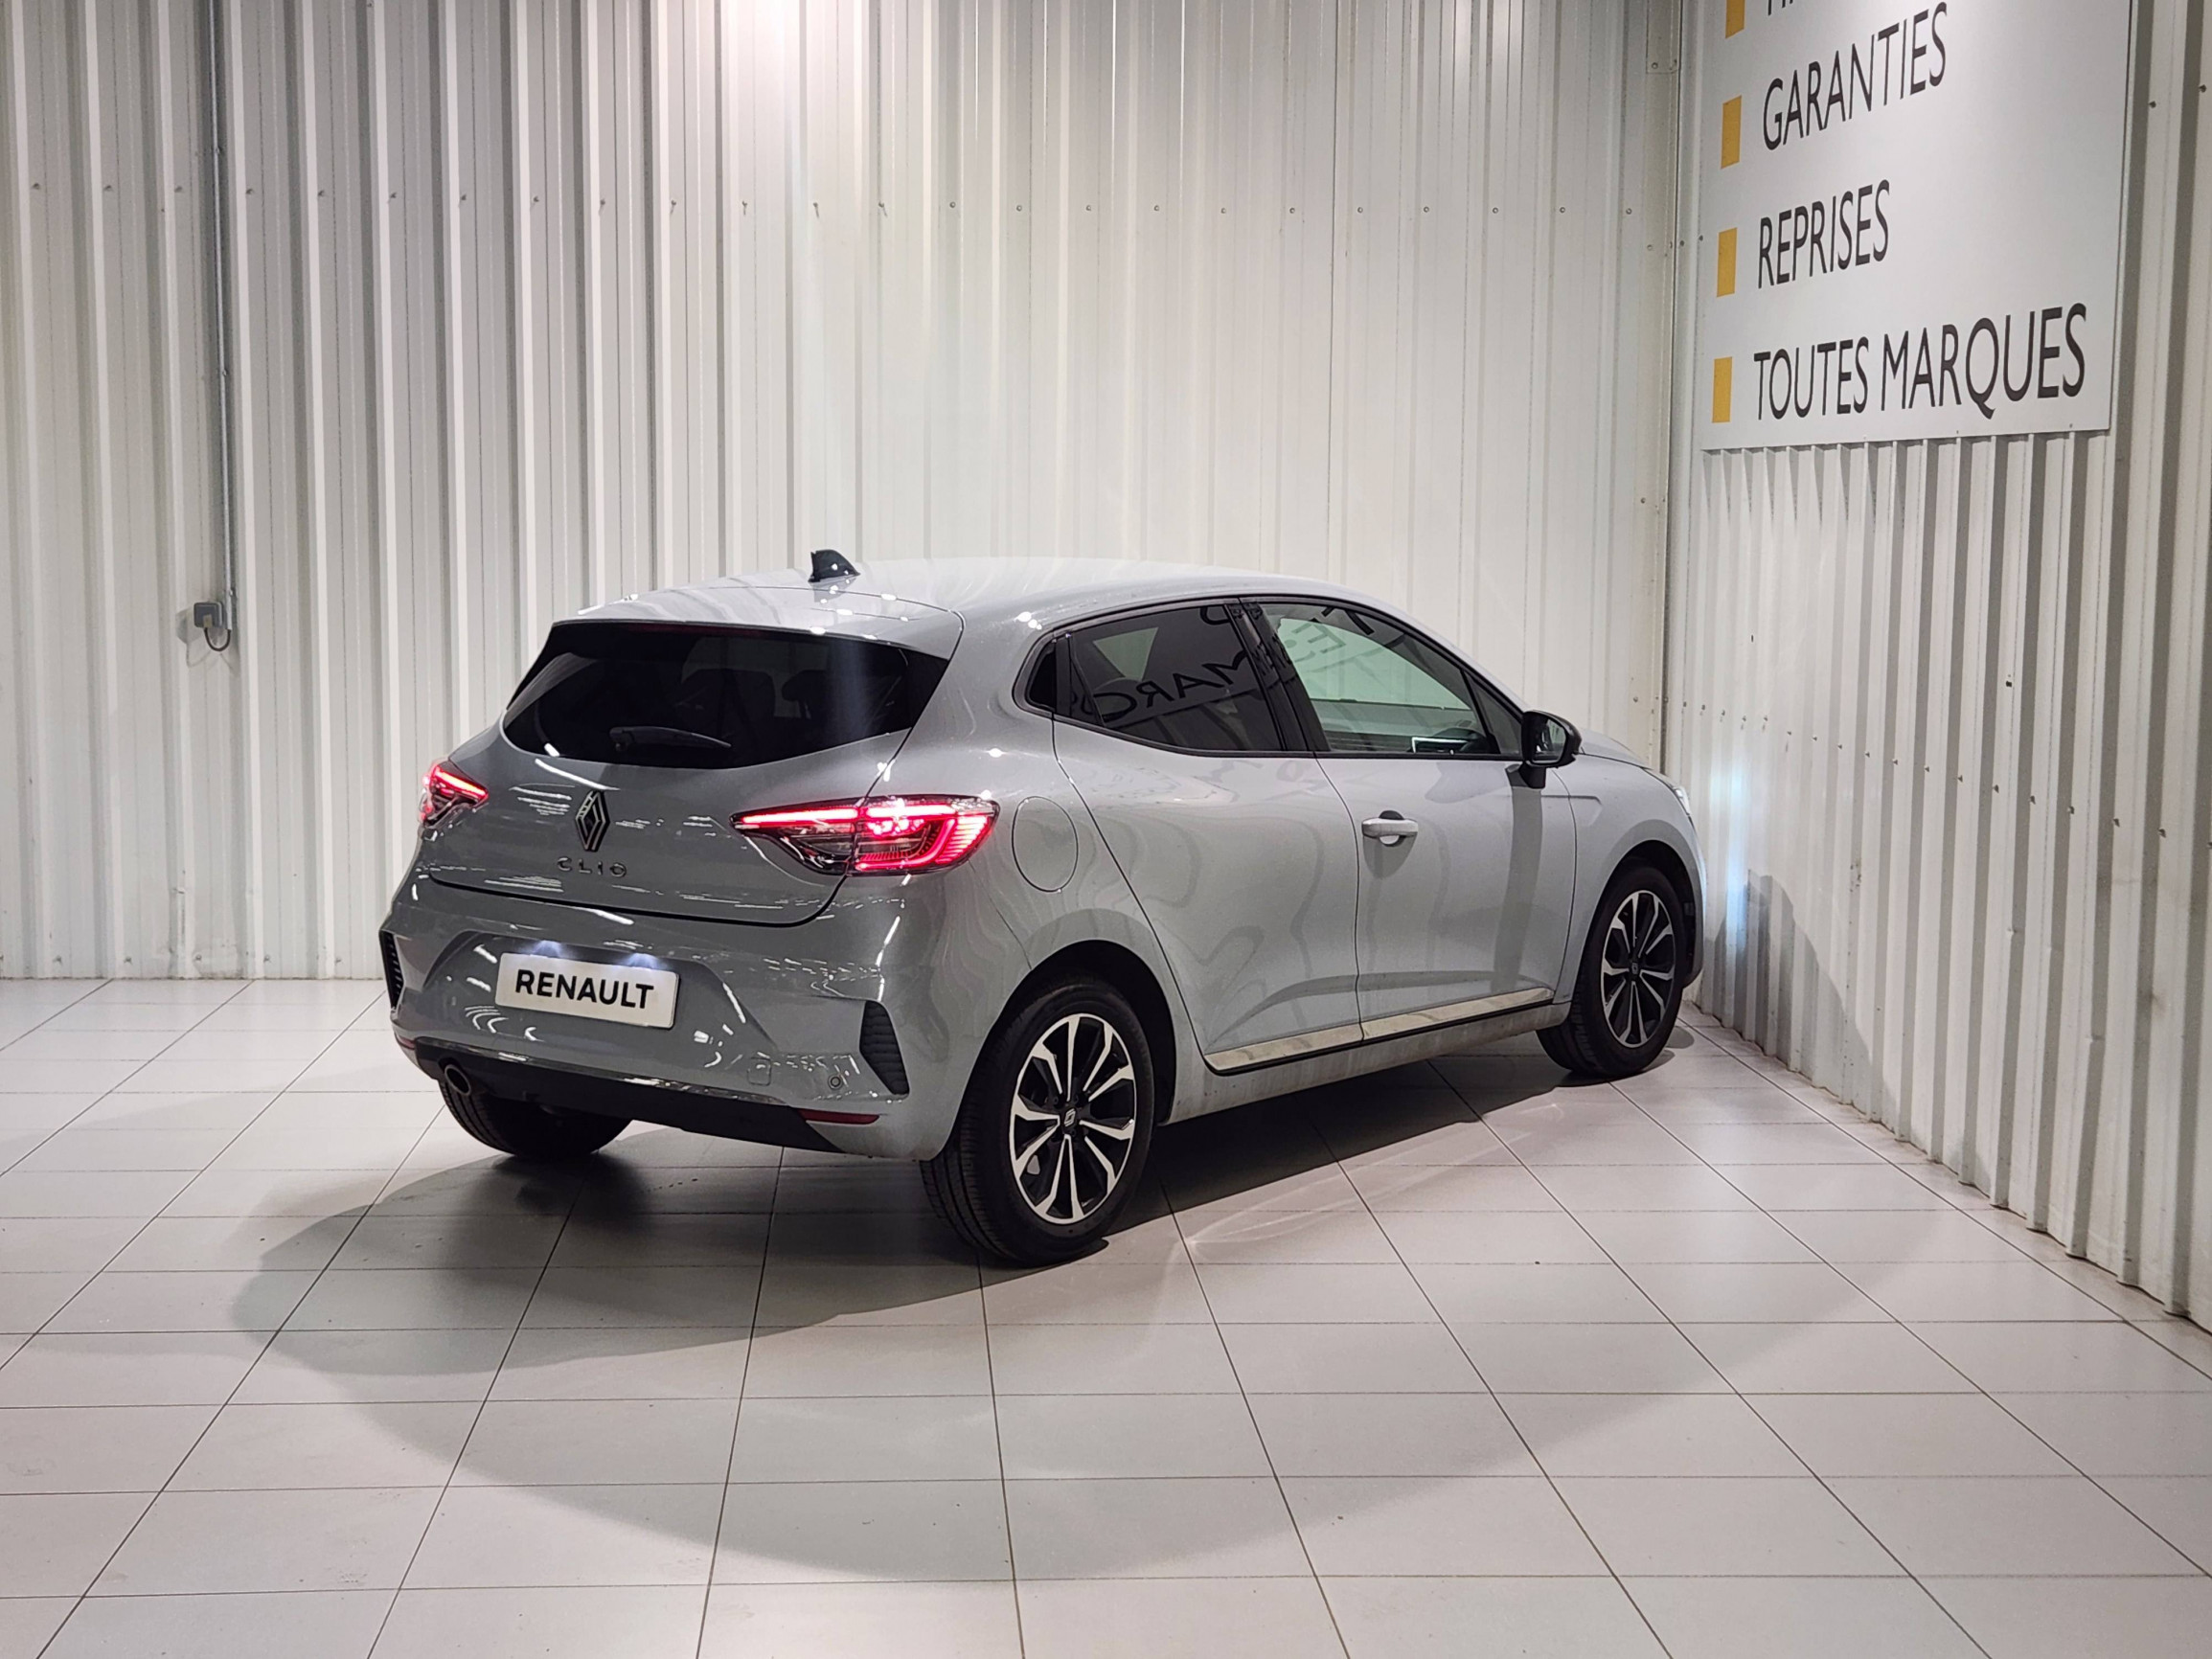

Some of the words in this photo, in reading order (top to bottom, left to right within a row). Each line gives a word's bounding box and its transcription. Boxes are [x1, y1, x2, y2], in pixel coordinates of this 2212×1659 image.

[1763, 2, 1948, 150] GARANTIES
[1758, 179, 1890, 289] REPRISES
[1753, 336, 1869, 420] TOUTES
[1881, 303, 2087, 420] MARQUES
[558, 856, 627, 877] CLIO
[515, 969, 654, 1009] RENAULT
